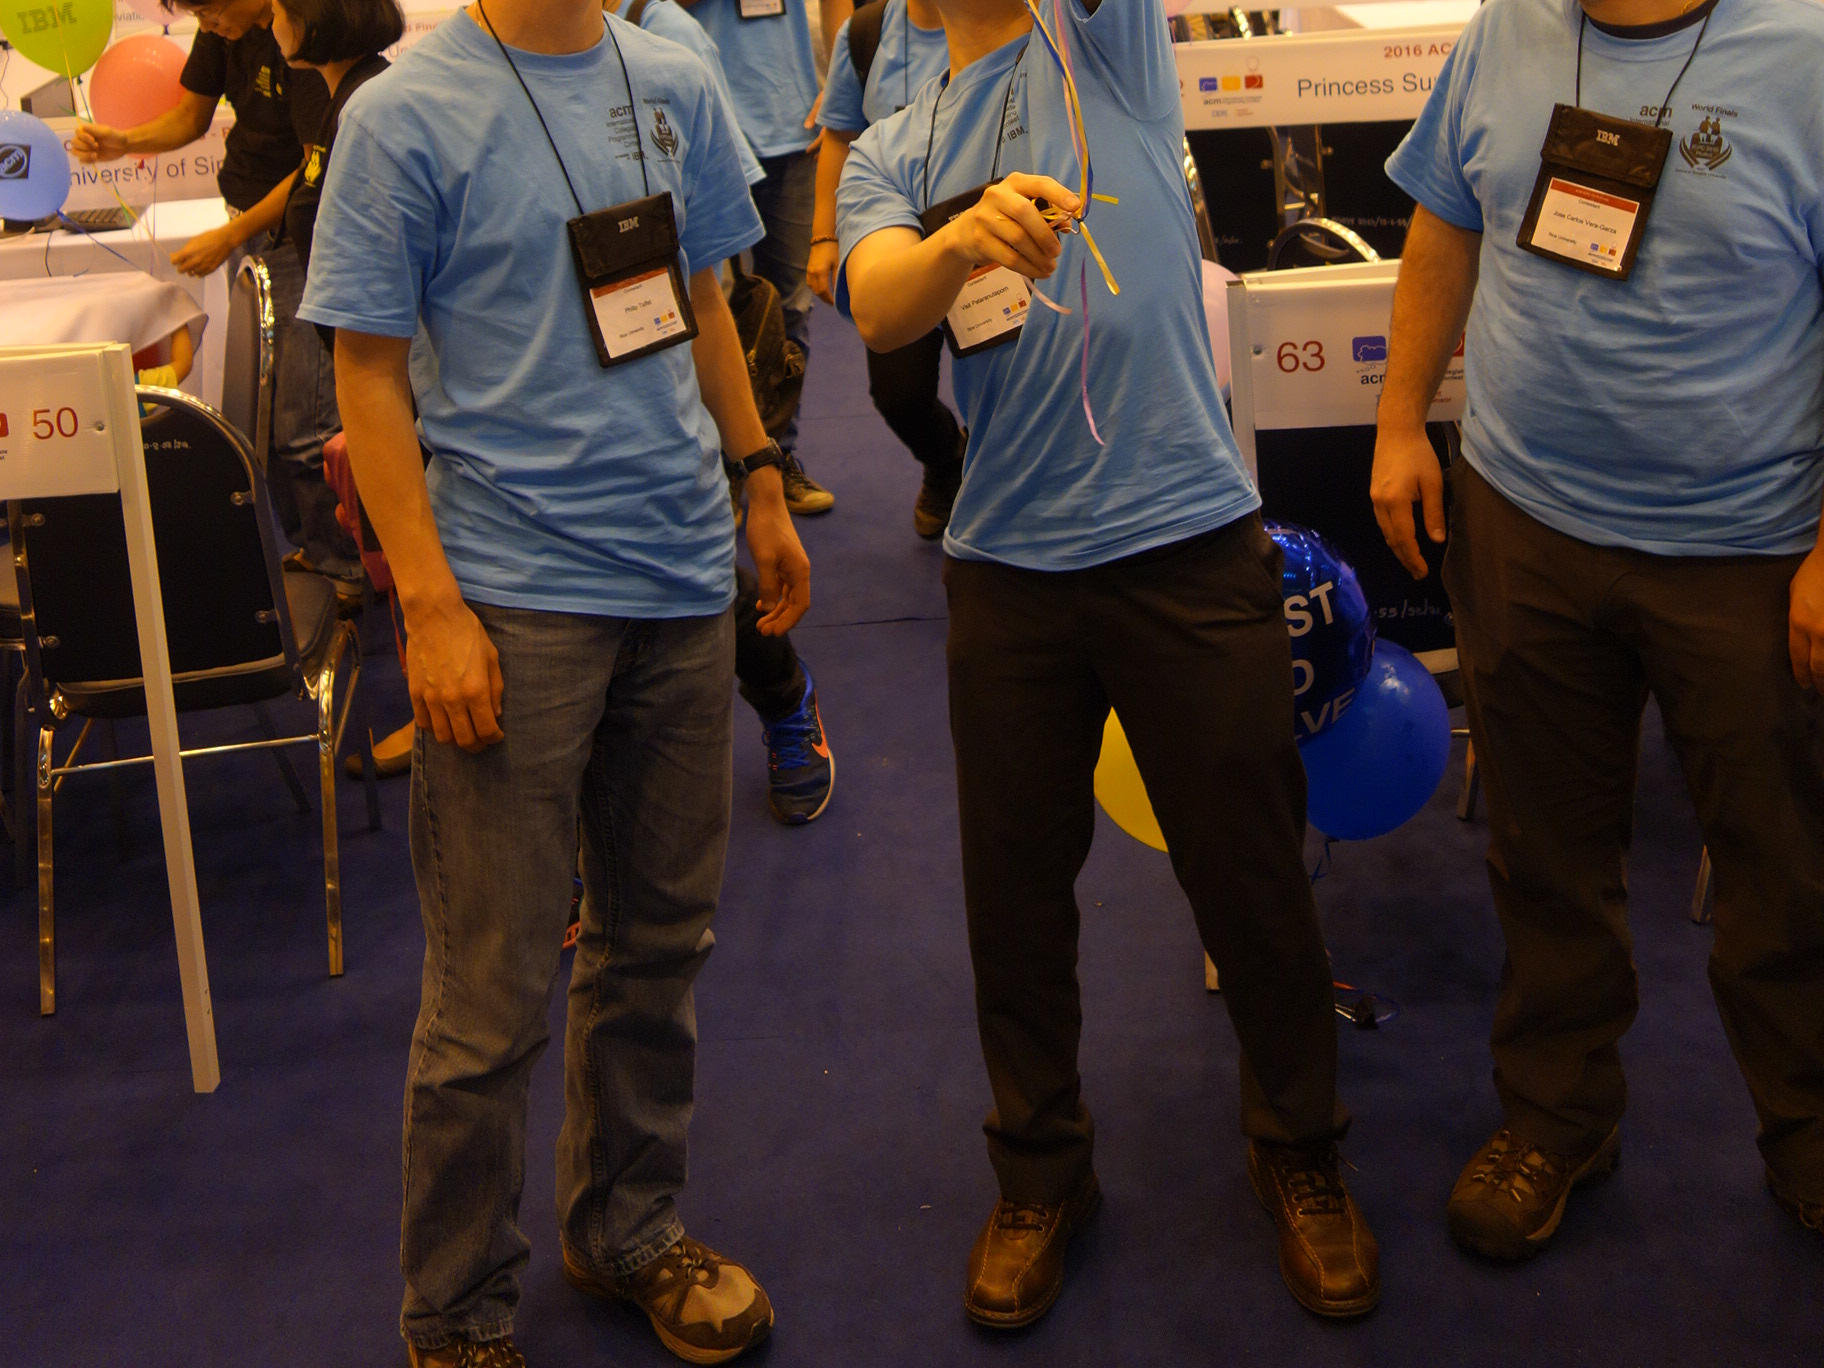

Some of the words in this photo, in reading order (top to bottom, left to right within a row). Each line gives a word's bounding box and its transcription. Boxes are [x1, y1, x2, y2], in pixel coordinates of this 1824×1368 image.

[17, 1, 78, 34] IBM
[1384, 44, 1423, 59] 2016
[1428, 42, 1452, 57] AC
[1298, 76, 1395, 98] Princess
[1596, 129, 1621, 146] IBM
[166, 158, 185, 179] of
[618, 216, 640, 233] IBM
[1276, 340, 1326, 373] 63
[32, 406, 79, 440] 50
